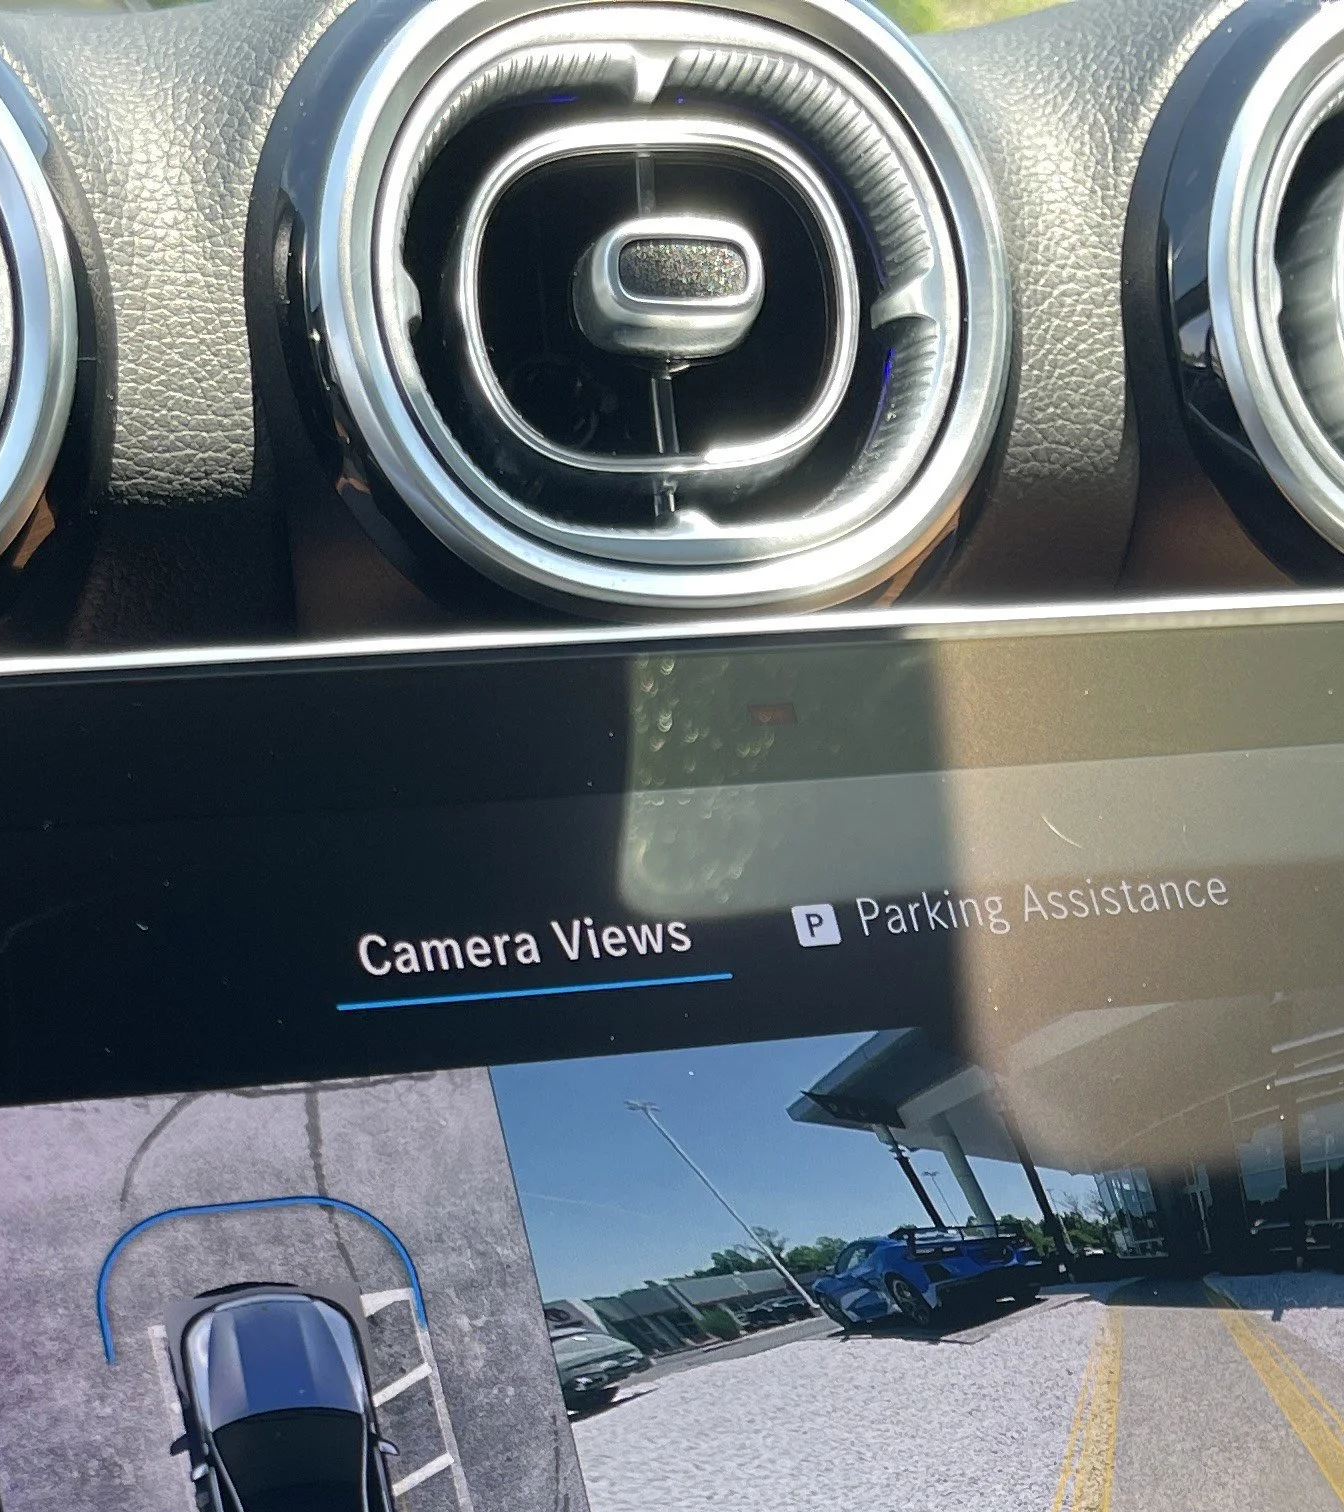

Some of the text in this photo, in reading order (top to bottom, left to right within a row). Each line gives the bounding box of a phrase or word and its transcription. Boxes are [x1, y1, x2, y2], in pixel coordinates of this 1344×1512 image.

[855, 889, 1012, 938] Parking
[1021, 872, 1229, 921] Assistance
[357, 916, 692, 977] Camera Views
